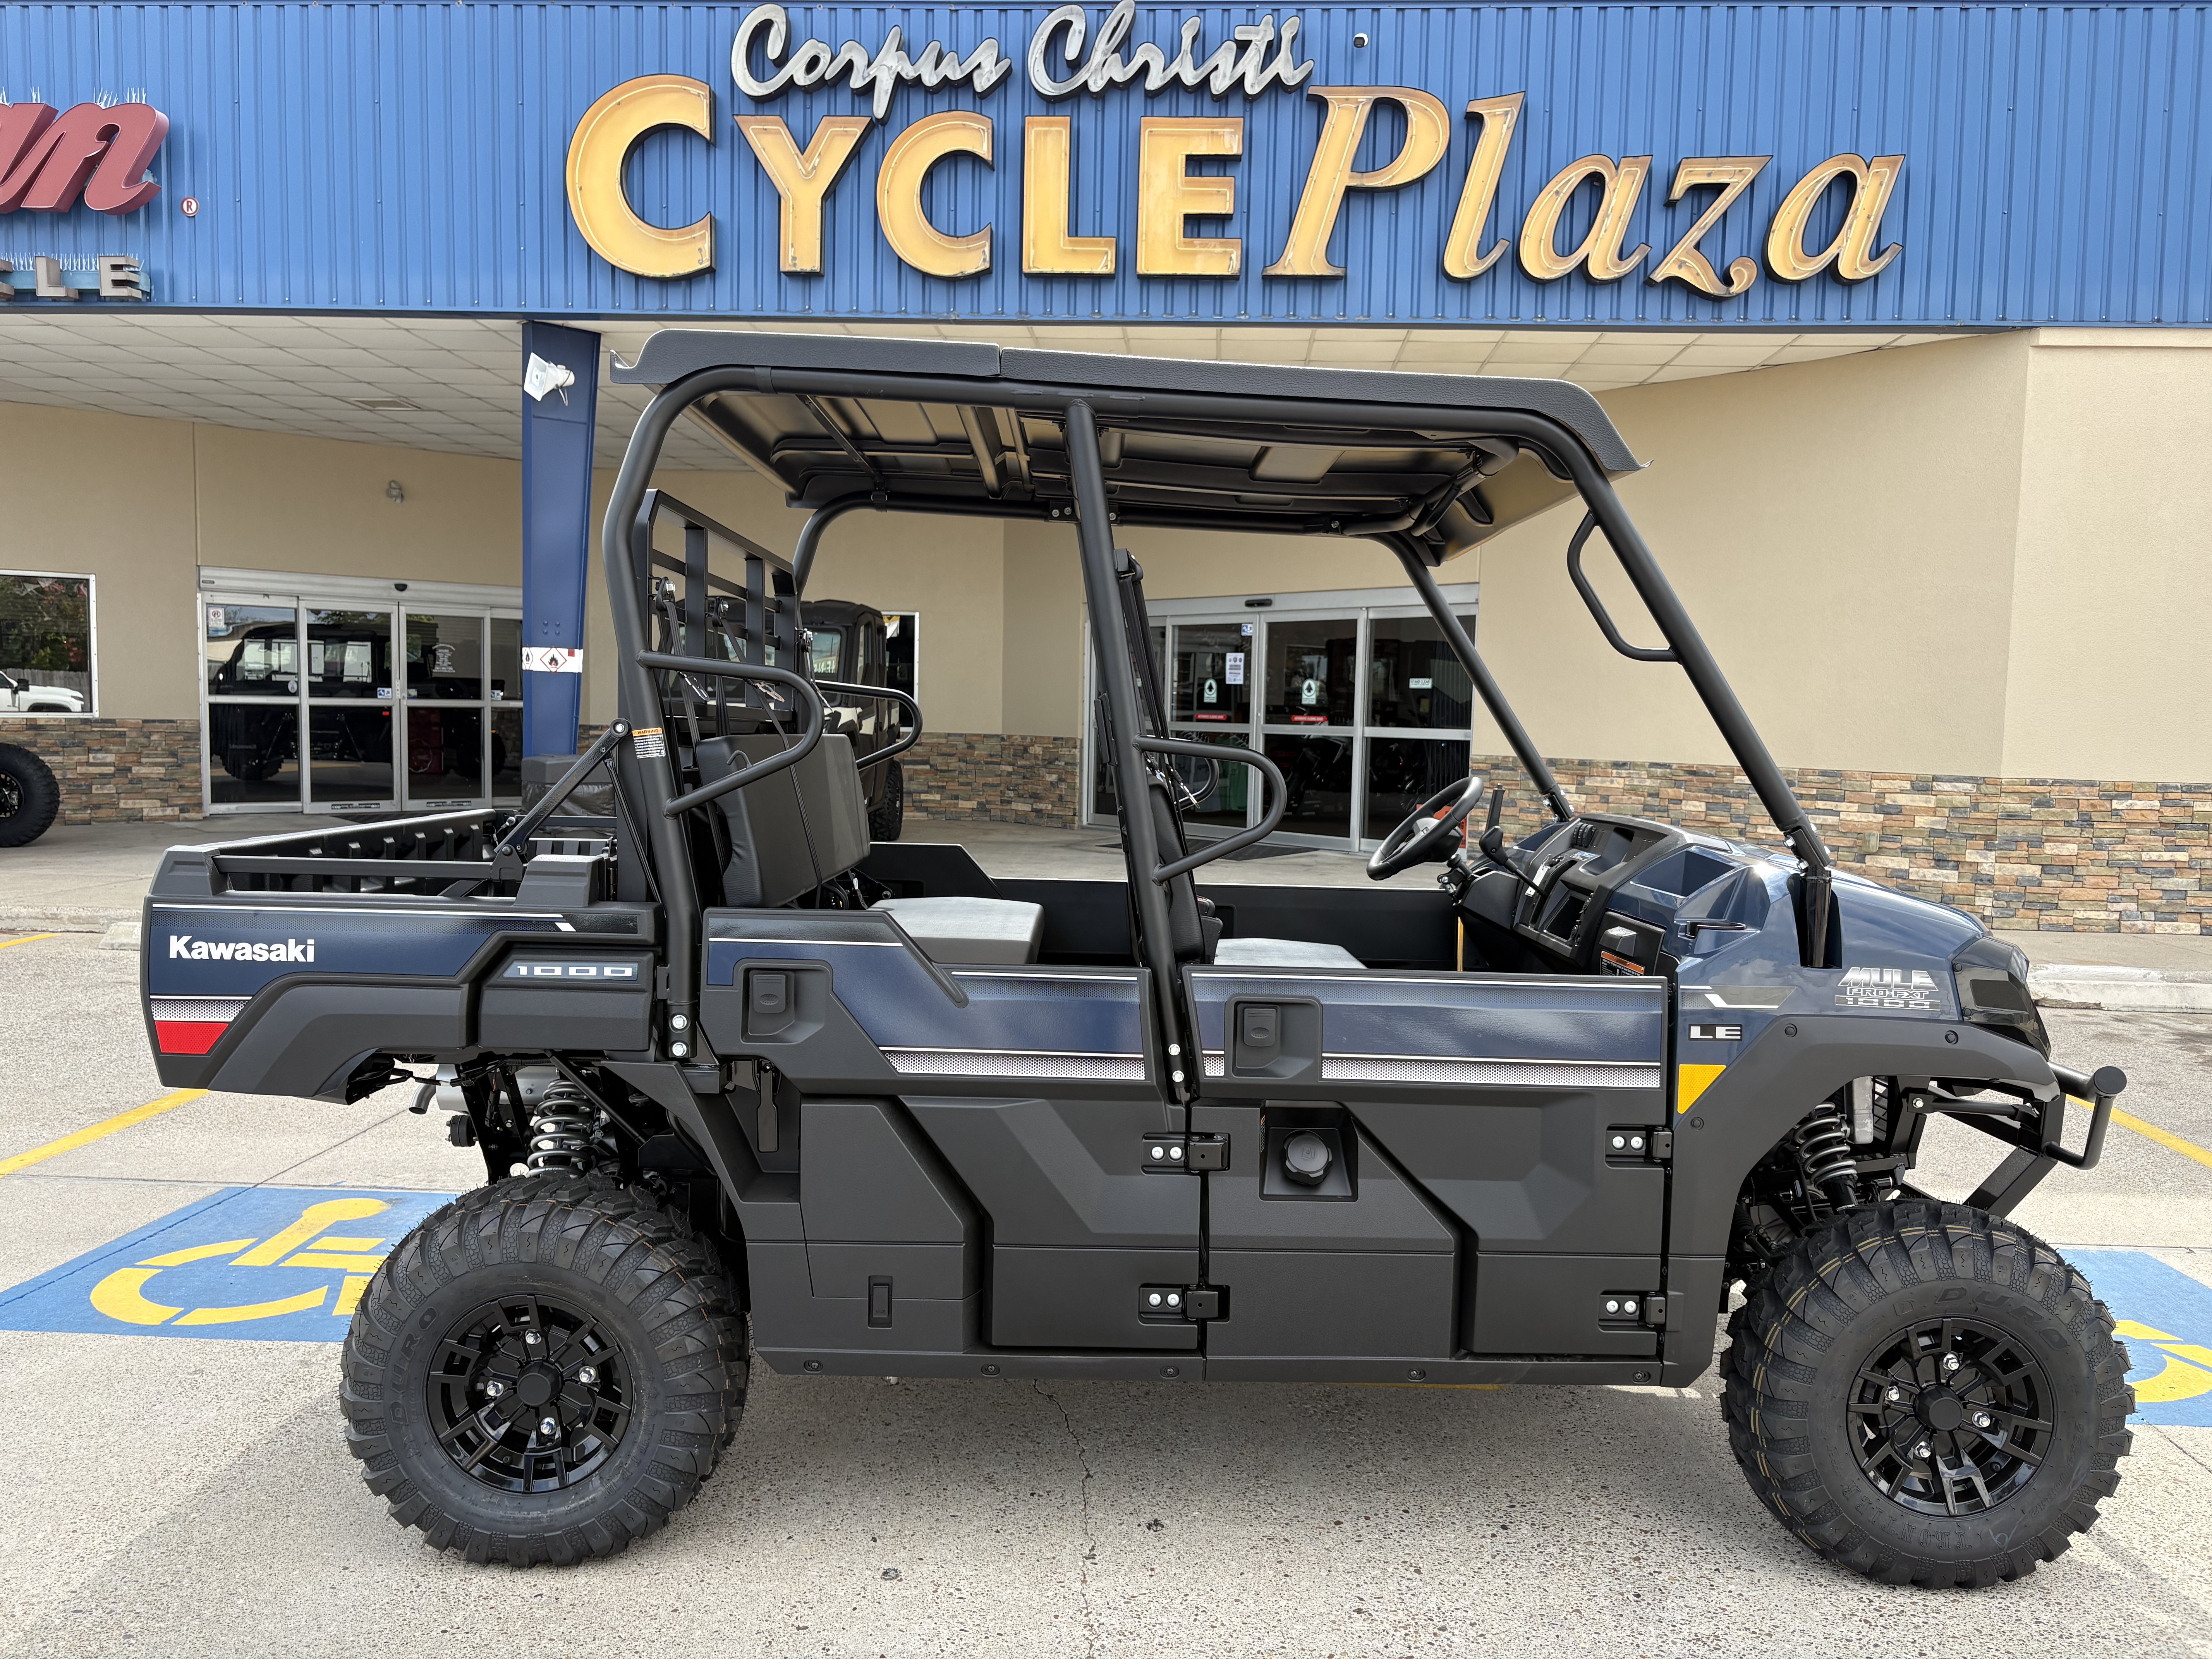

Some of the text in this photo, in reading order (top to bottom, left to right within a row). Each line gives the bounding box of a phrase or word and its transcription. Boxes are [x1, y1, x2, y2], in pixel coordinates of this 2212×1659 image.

[731, 0, 1314, 125] Corpus Christi
[565, 73, 1906, 301] CYCLE Plaza
[169, 934, 315, 963] Kawasaki
[517, 966, 632, 976] 1000
[1838, 967, 1939, 991] MULE
[1845, 997, 1930, 1009] 1000
[1690, 1025, 1742, 1040] LE
[1935, 1286, 2070, 1351] DURO
[390, 1306, 438, 1425] DURO
[1842, 1479, 1973, 1550] FRONTIER
